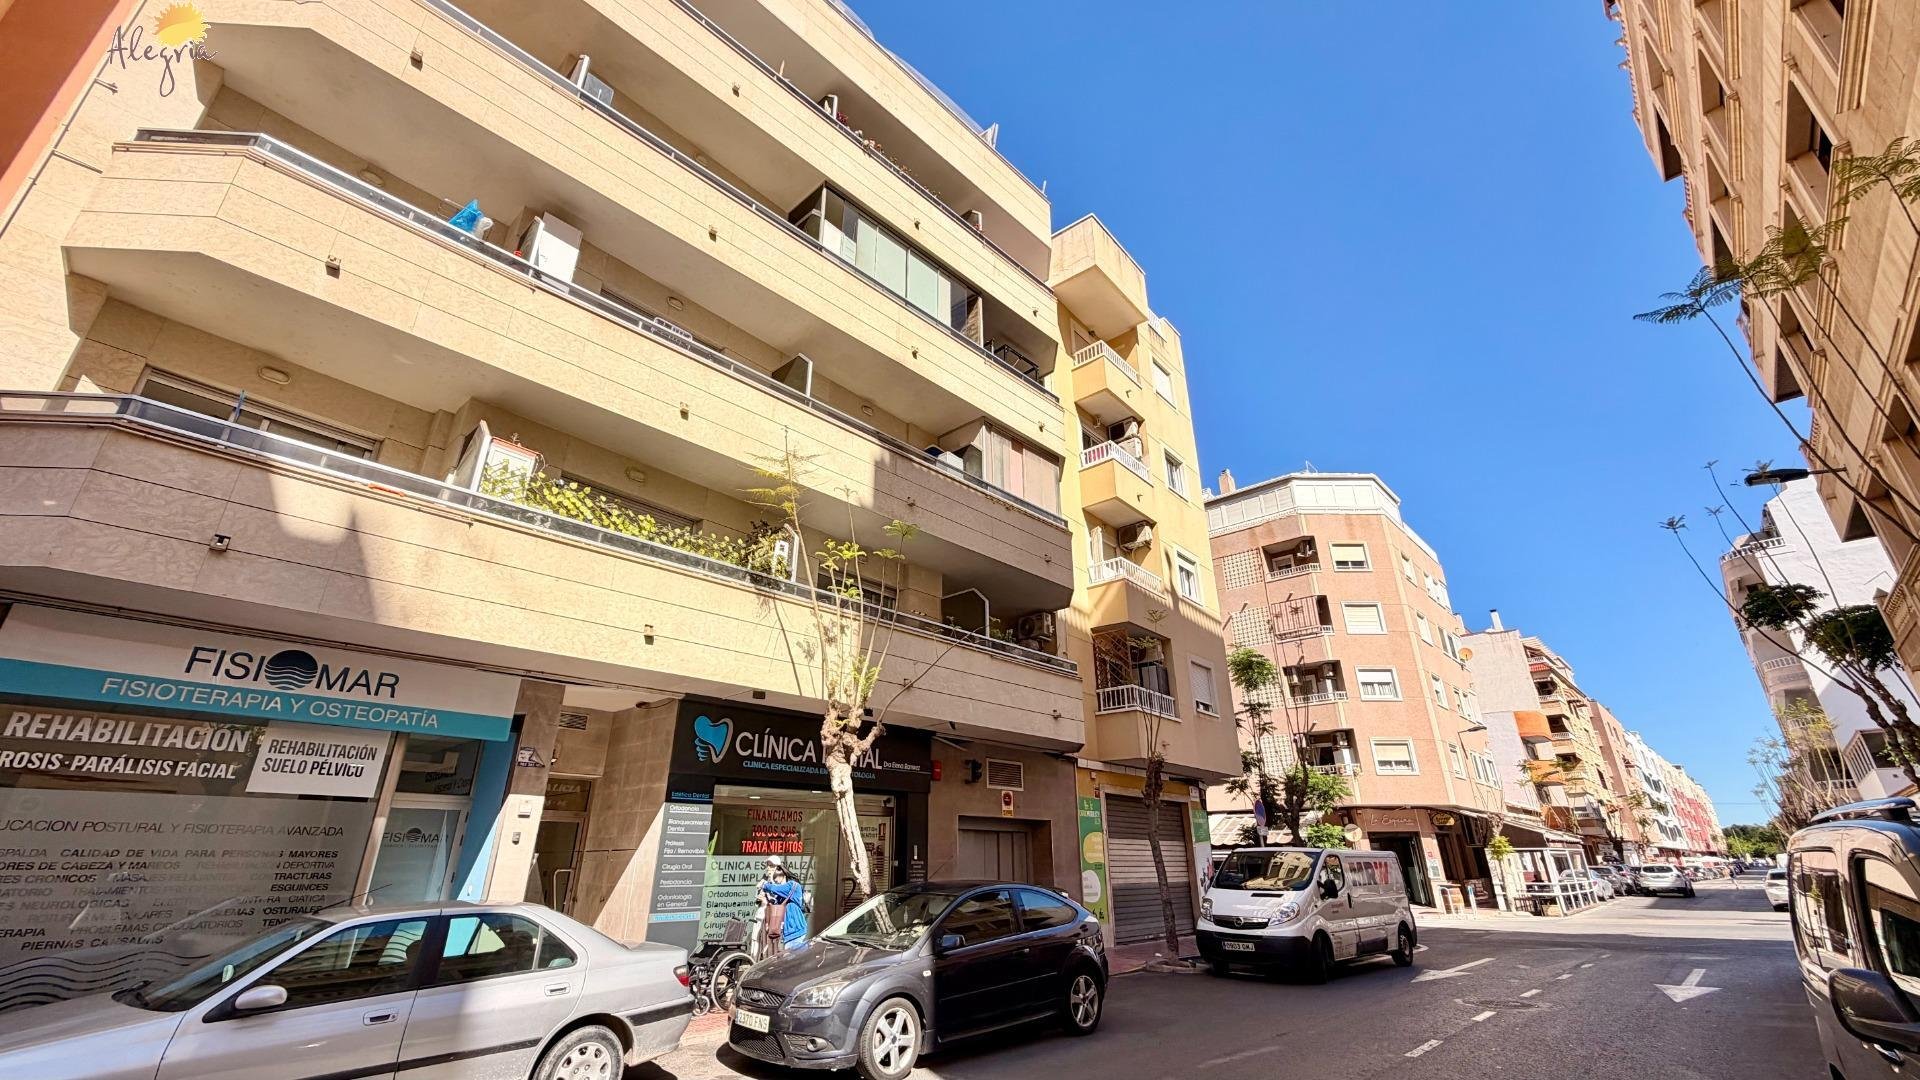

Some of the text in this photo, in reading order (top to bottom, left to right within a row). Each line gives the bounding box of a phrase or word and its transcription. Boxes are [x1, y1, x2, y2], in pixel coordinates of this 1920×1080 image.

[184, 646, 400, 698] FISIOMAR
[101, 677, 439, 728] FISIOTERAPIA Y OSTEOPATÍA
[268, 739, 378, 761] REHABILITACIÓN
[735, 728, 817, 763] CLÍNICA
[174, 761, 239, 779] FACIAL
[261, 757, 365, 778] SUELO PÉLVICO
[743, 760, 770, 771] CLINICA
[747, 808, 803, 822] FINANCIAMOS
[82, 821, 166, 834] POSTURAL
[171, 823, 181, 833] Y
[184, 823, 274, 835] FISIOTERAPIA
[751, 824, 779, 837] TODOS
[741, 839, 804, 853] TRATAMIENTOS
[60, 849, 120, 858] CALIDAD
[126, 850, 145, 858] DE
[151, 850, 178, 858] VIDA
[184, 850, 216, 858] PARA
[289, 850, 338, 859] MAYORES
[38, 861, 57, 870] DE
[61, 861, 113, 870] CABEZA
[282, 862, 335, 870] DEPORTIVA
[711, 860, 752, 871] CLINICA
[24, 874, 97, 884] CRONICOS
[721, 873, 737, 883] EN
[270, 883, 329, 892] ESGUINCES
[707, 890, 749, 899] Ortodoncia
[21, 940, 84, 951] PIERNAS
